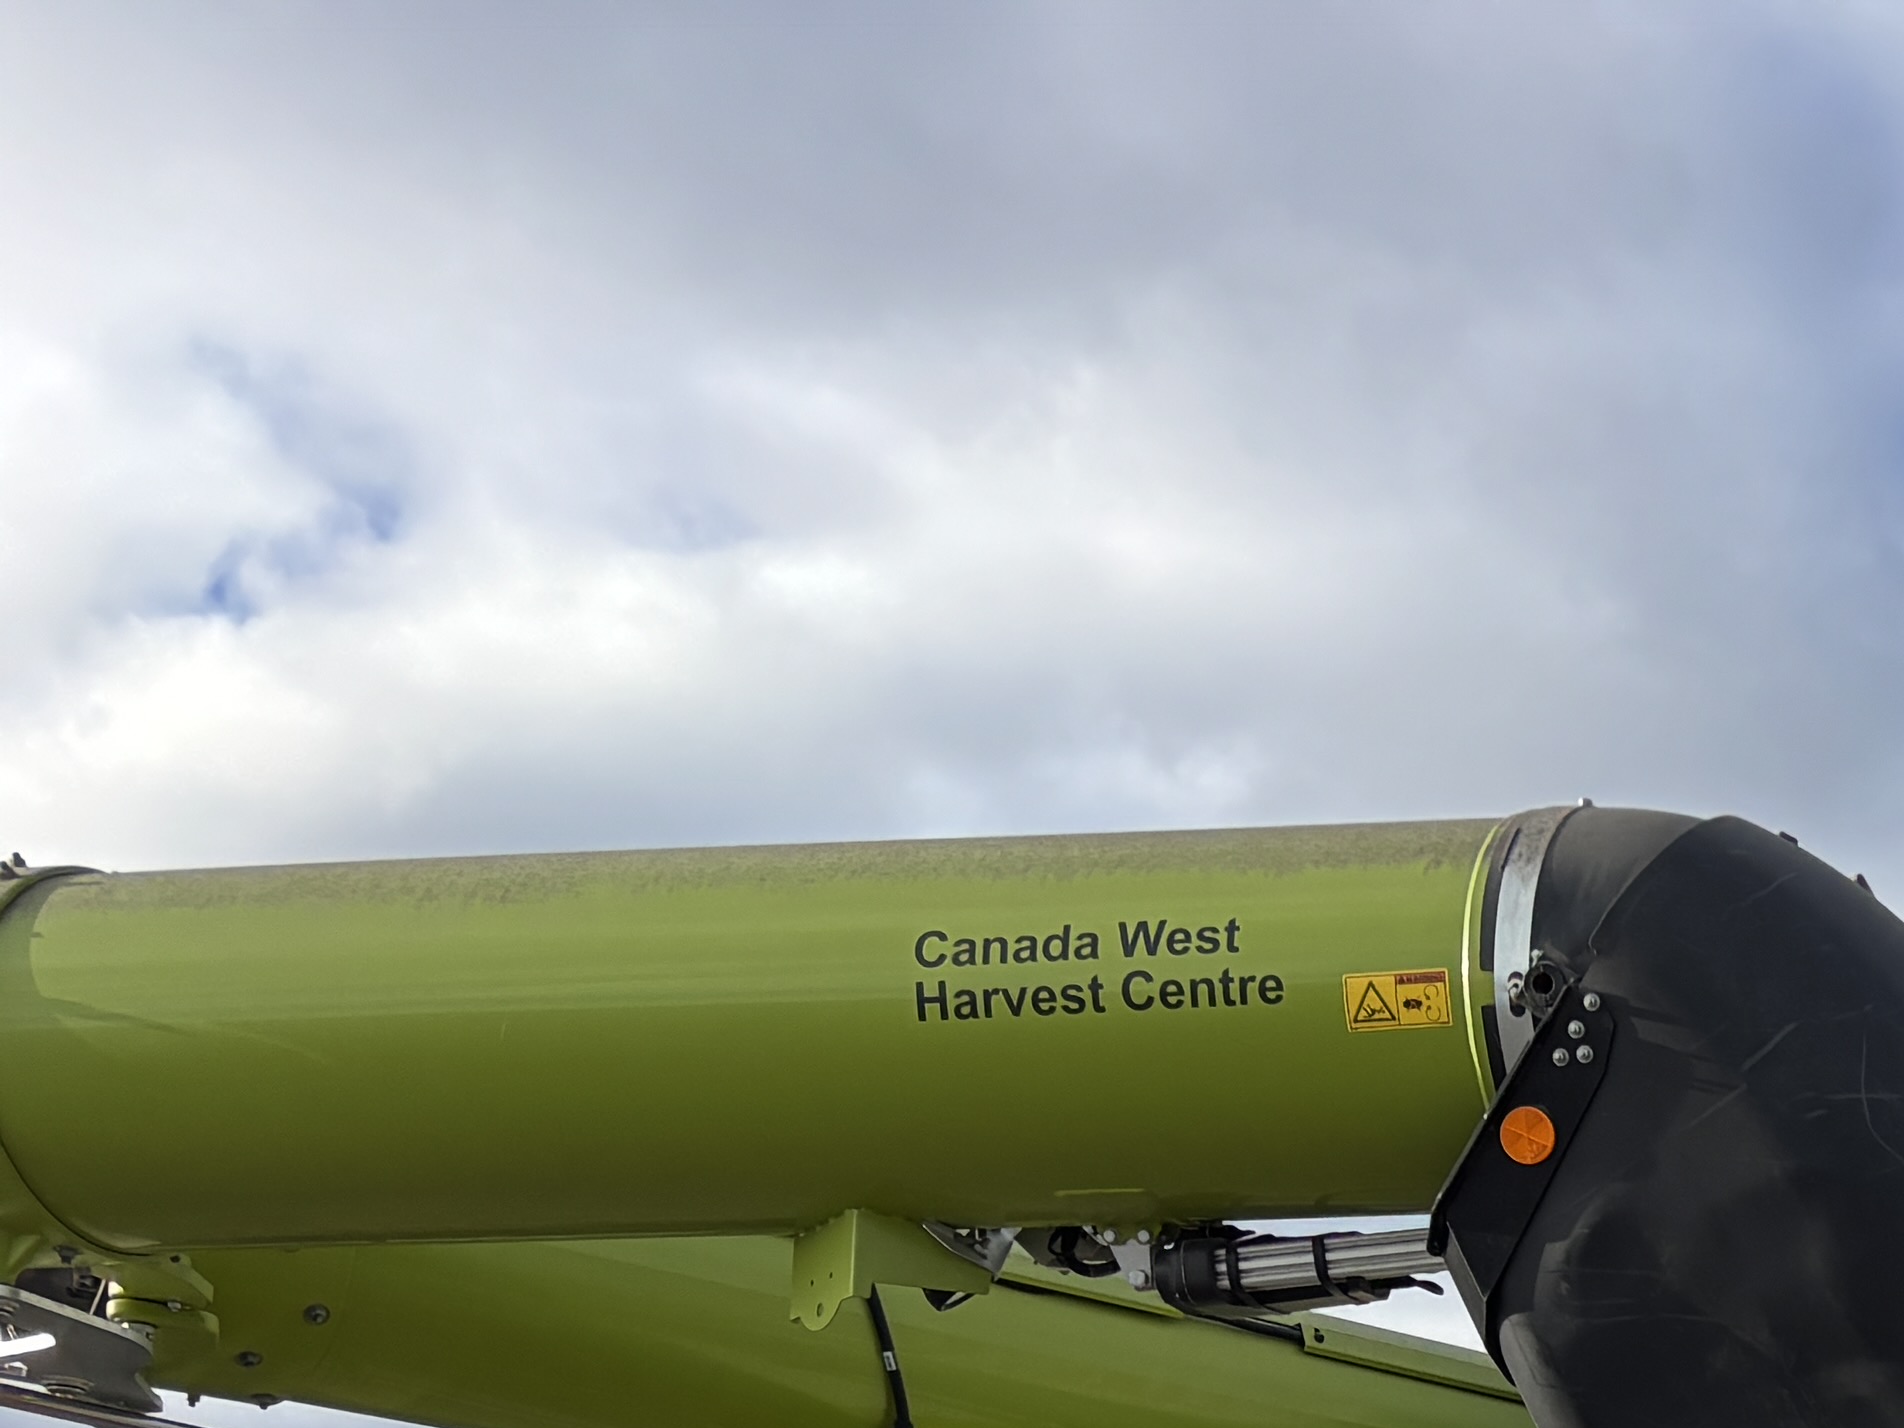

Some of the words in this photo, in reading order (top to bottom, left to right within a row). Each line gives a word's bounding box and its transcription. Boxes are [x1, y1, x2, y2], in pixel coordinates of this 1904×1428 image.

[914, 924, 1101, 969] Canada
[1117, 917, 1242, 959] West
[914, 975, 1106, 1022] Harvest
[1121, 967, 1286, 1012] Centre
